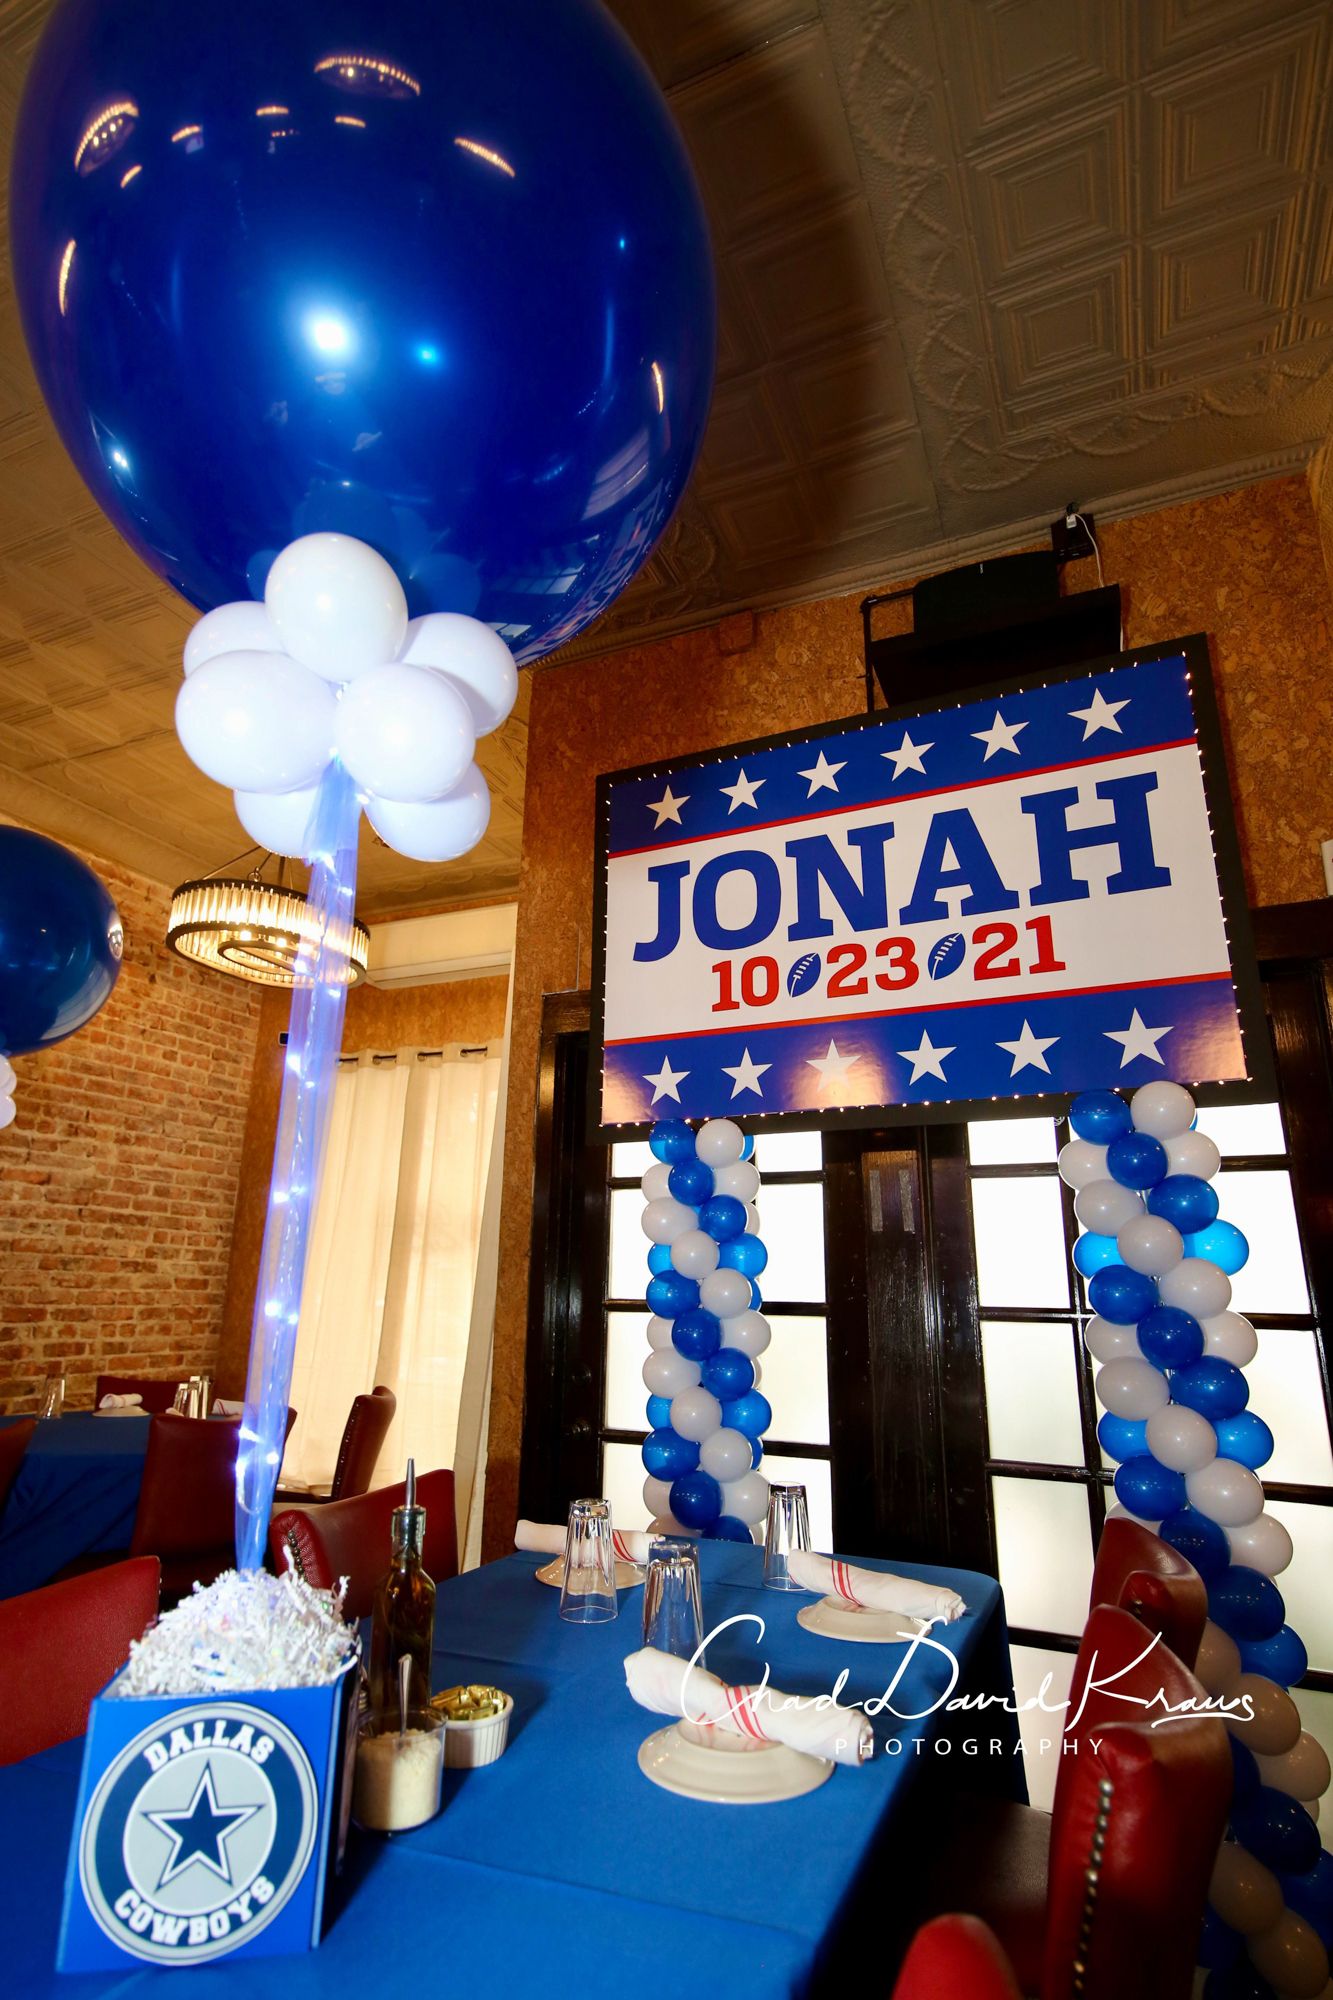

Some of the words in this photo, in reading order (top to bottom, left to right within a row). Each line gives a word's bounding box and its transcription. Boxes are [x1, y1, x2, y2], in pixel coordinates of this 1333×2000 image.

[633, 771, 1172, 962] JONAH
[711, 955, 780, 1012] 10
[826, 935, 920, 998] 23
[972, 915, 1066, 981] 21
[143, 1719, 276, 1772] DALLAS
[114, 1875, 276, 1946] COWBOYS
